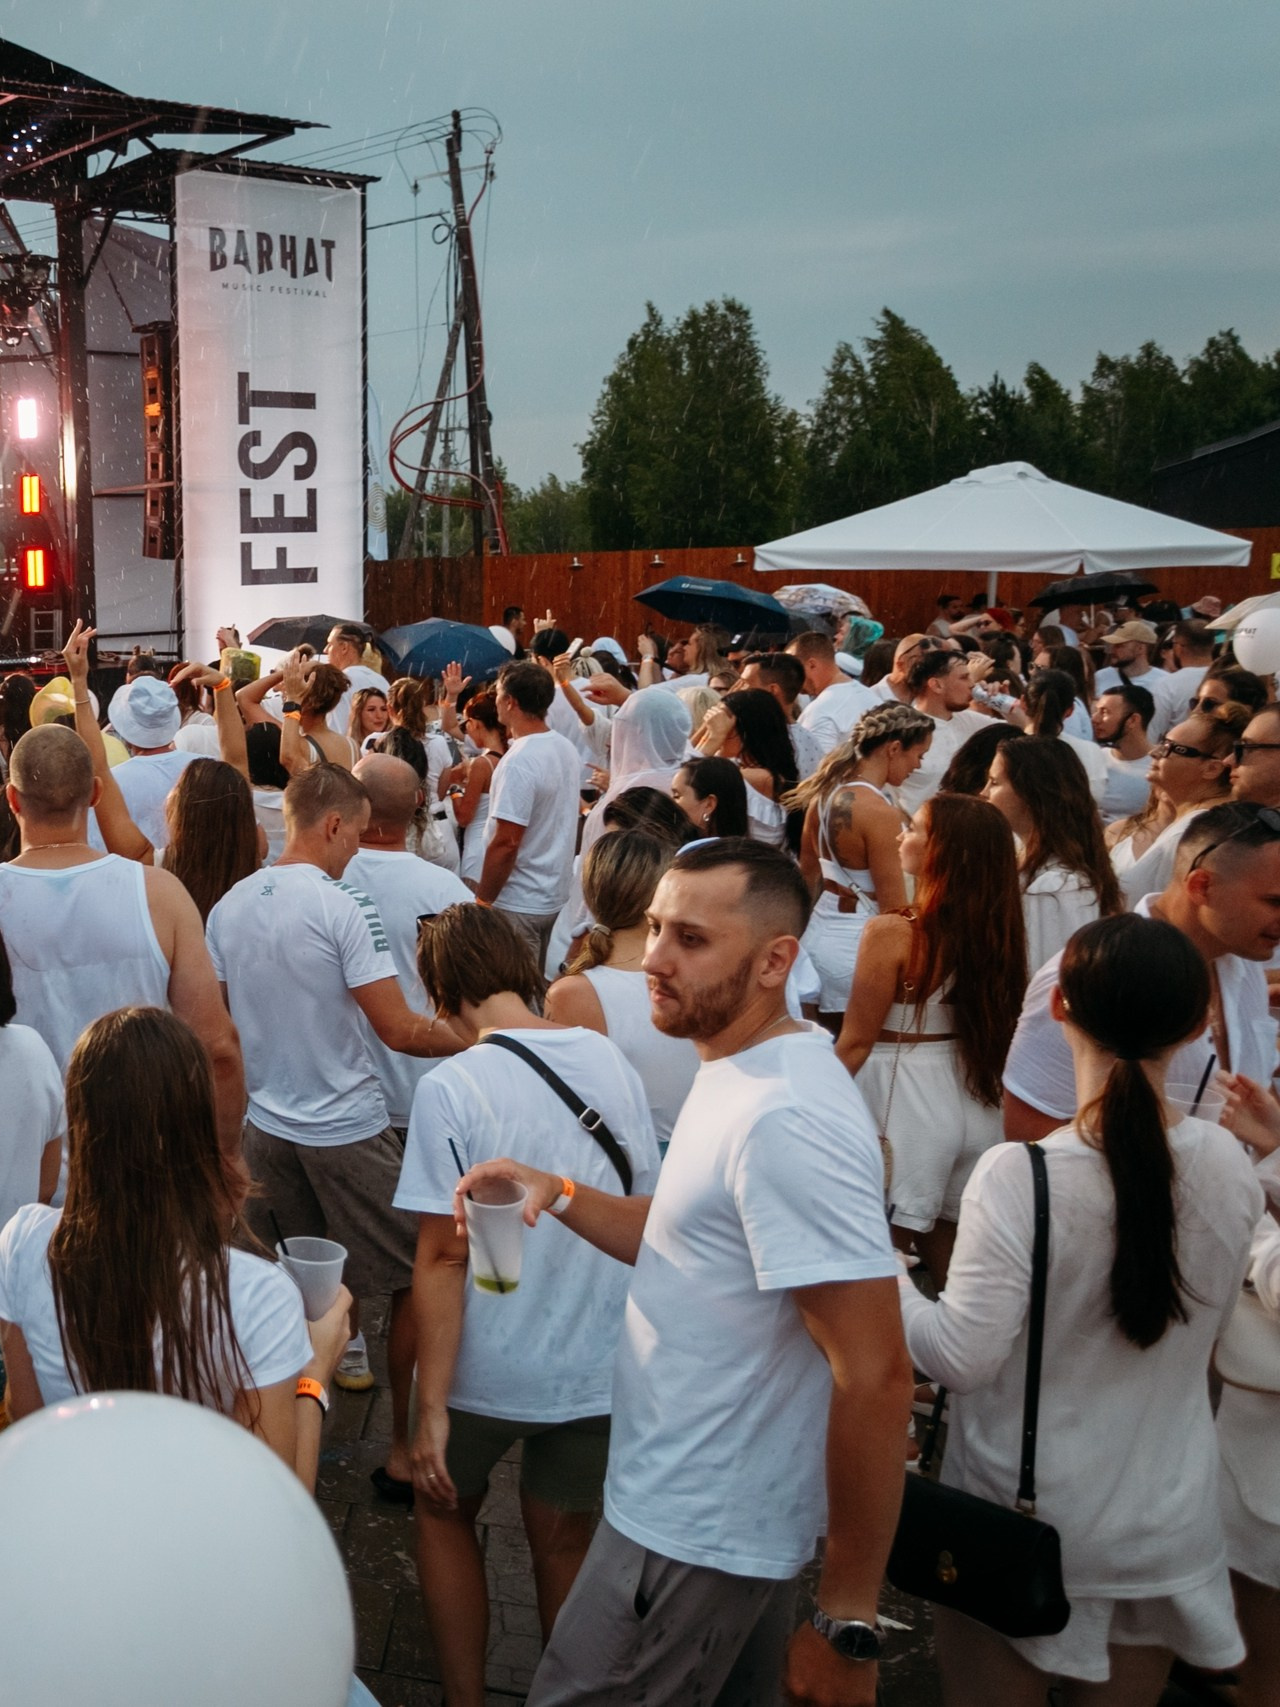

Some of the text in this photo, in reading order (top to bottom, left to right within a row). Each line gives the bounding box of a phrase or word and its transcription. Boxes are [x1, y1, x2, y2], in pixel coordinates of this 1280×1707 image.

[208, 226, 336, 283] BARHAT
[221, 281, 328, 299] MUSIC FESTIVAL
[237, 371, 318, 586] FEST
